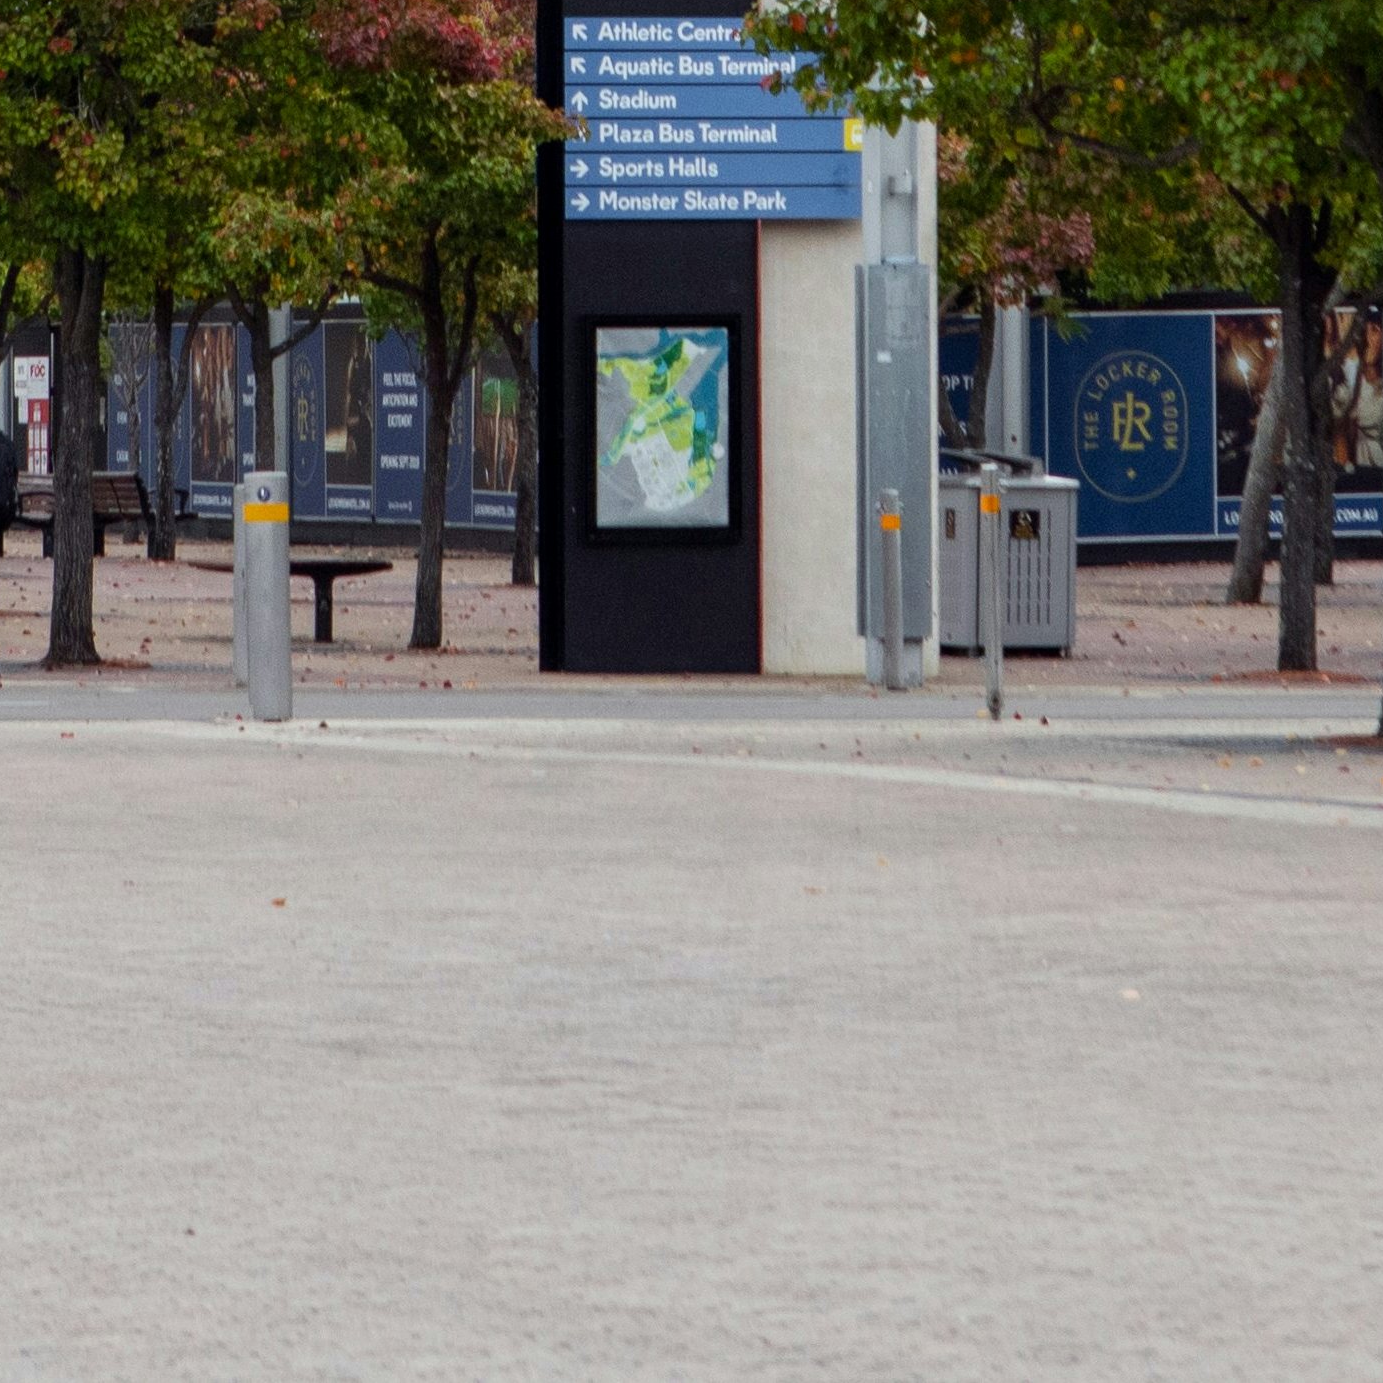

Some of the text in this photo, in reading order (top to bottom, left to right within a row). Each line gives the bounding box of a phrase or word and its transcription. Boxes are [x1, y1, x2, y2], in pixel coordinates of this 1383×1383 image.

[598, 21, 672, 42] Athletic
[598, 55, 796, 80] Aquatic Bus Terminal
[599, 89, 677, 109] Stadium
[599, 122, 777, 143] Plaza Bus Terminal
[599, 157, 719, 181] Sports Halls
[599, 190, 786, 211] Monster Skate Park
[1083, 360, 1179, 451] THE LOCKER ROOM
